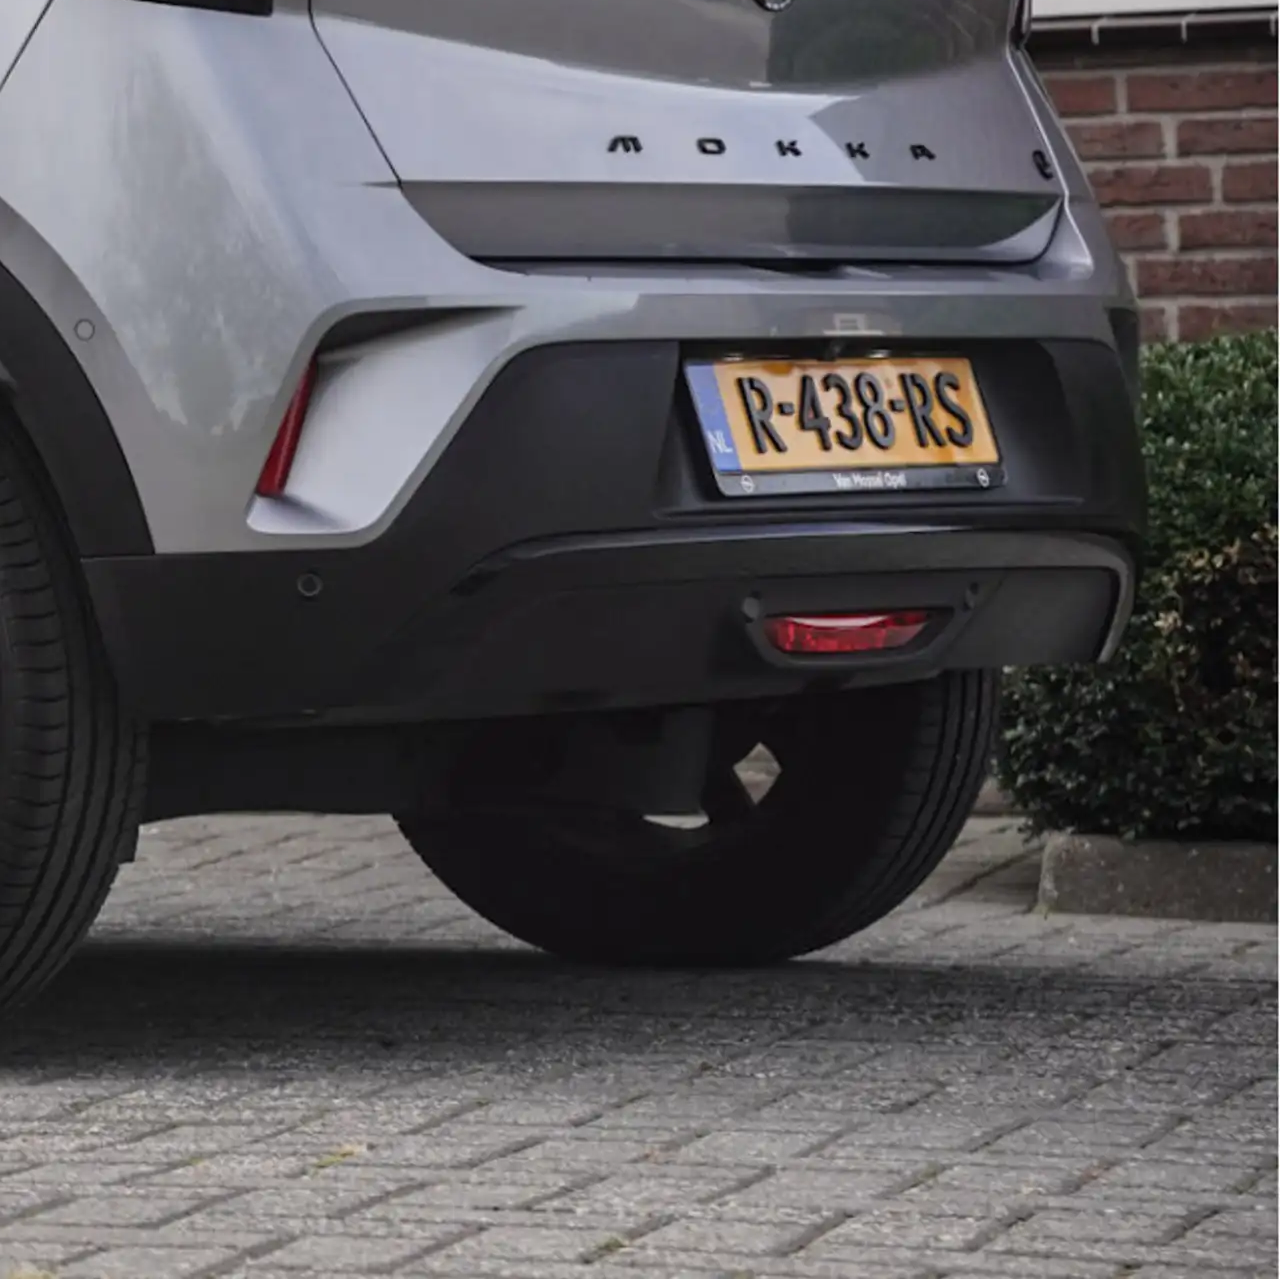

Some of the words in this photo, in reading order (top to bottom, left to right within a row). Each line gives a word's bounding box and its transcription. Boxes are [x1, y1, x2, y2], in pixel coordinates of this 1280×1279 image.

[606, 134, 937, 162] MOKKA
[736, 372, 974, 454] R-438-RS
[707, 429, 734, 455] NL
